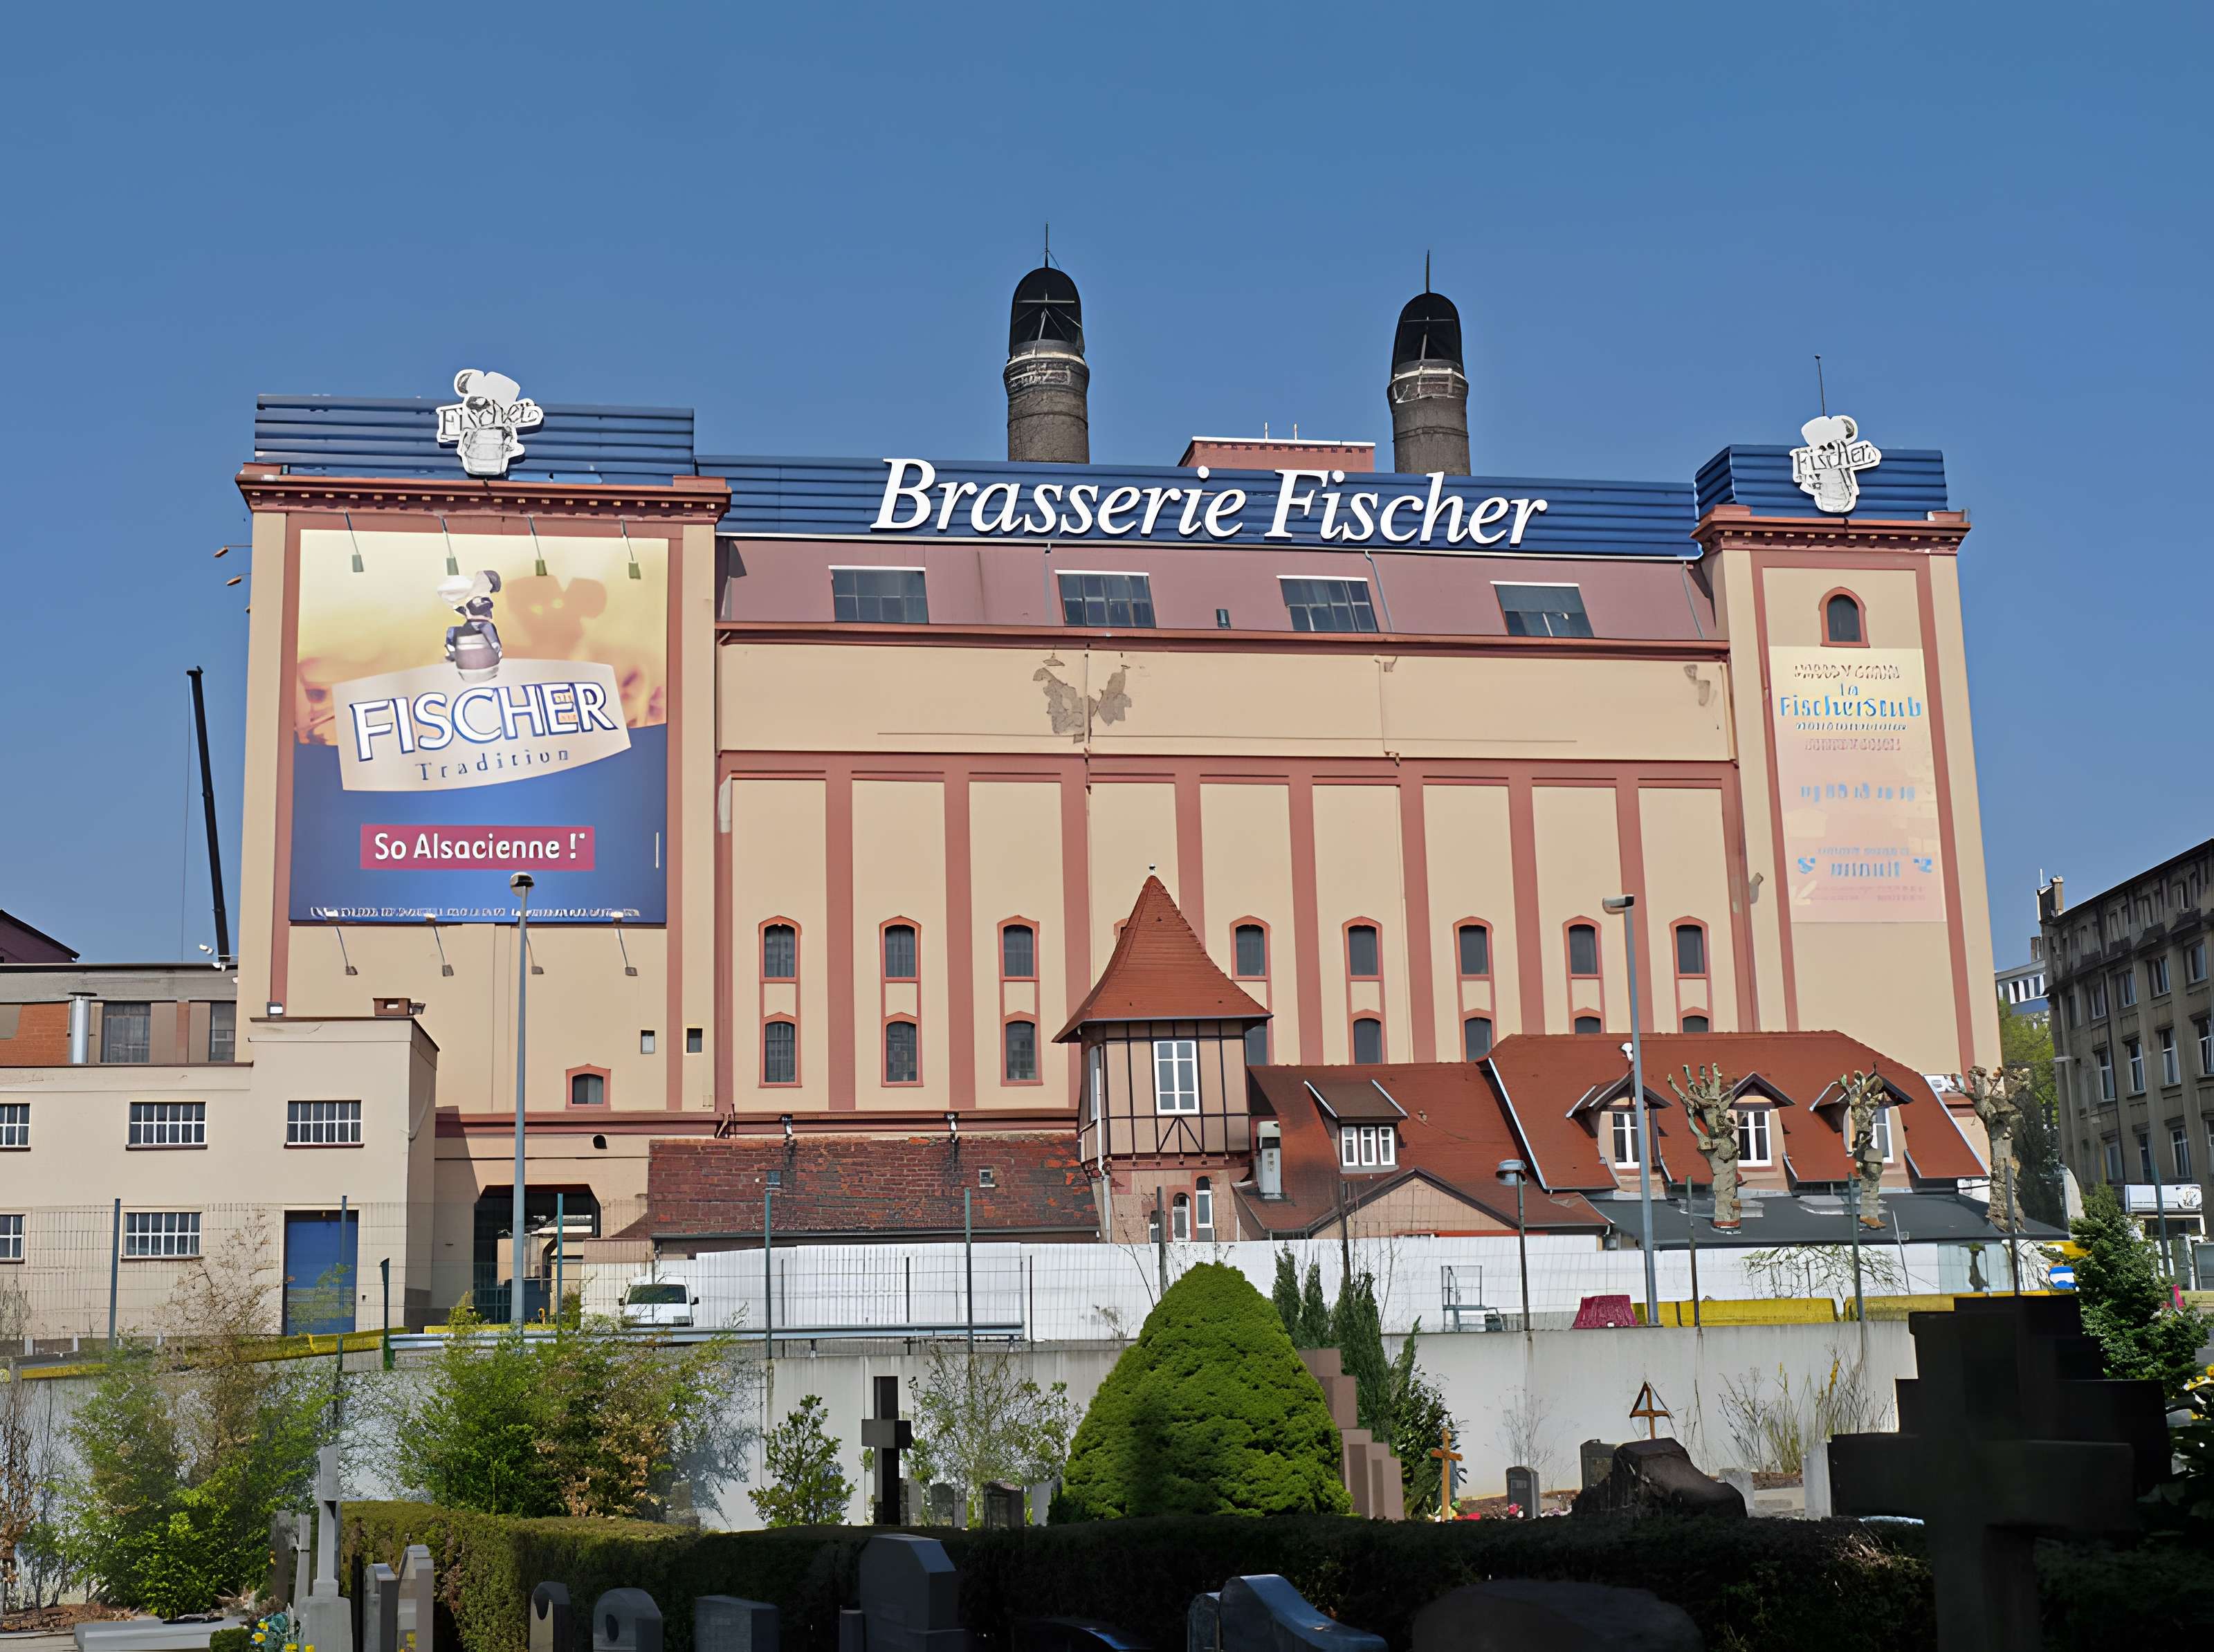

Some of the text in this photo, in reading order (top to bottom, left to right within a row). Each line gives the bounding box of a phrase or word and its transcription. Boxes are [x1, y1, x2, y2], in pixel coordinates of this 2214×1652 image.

[870, 458, 1548, 544] Brasserie Fischer
[349, 682, 619, 762] FISCHER
[415, 749, 569, 780] Tradition
[374, 832, 408, 860] So
[414, 832, 560, 860] Alsacienne
